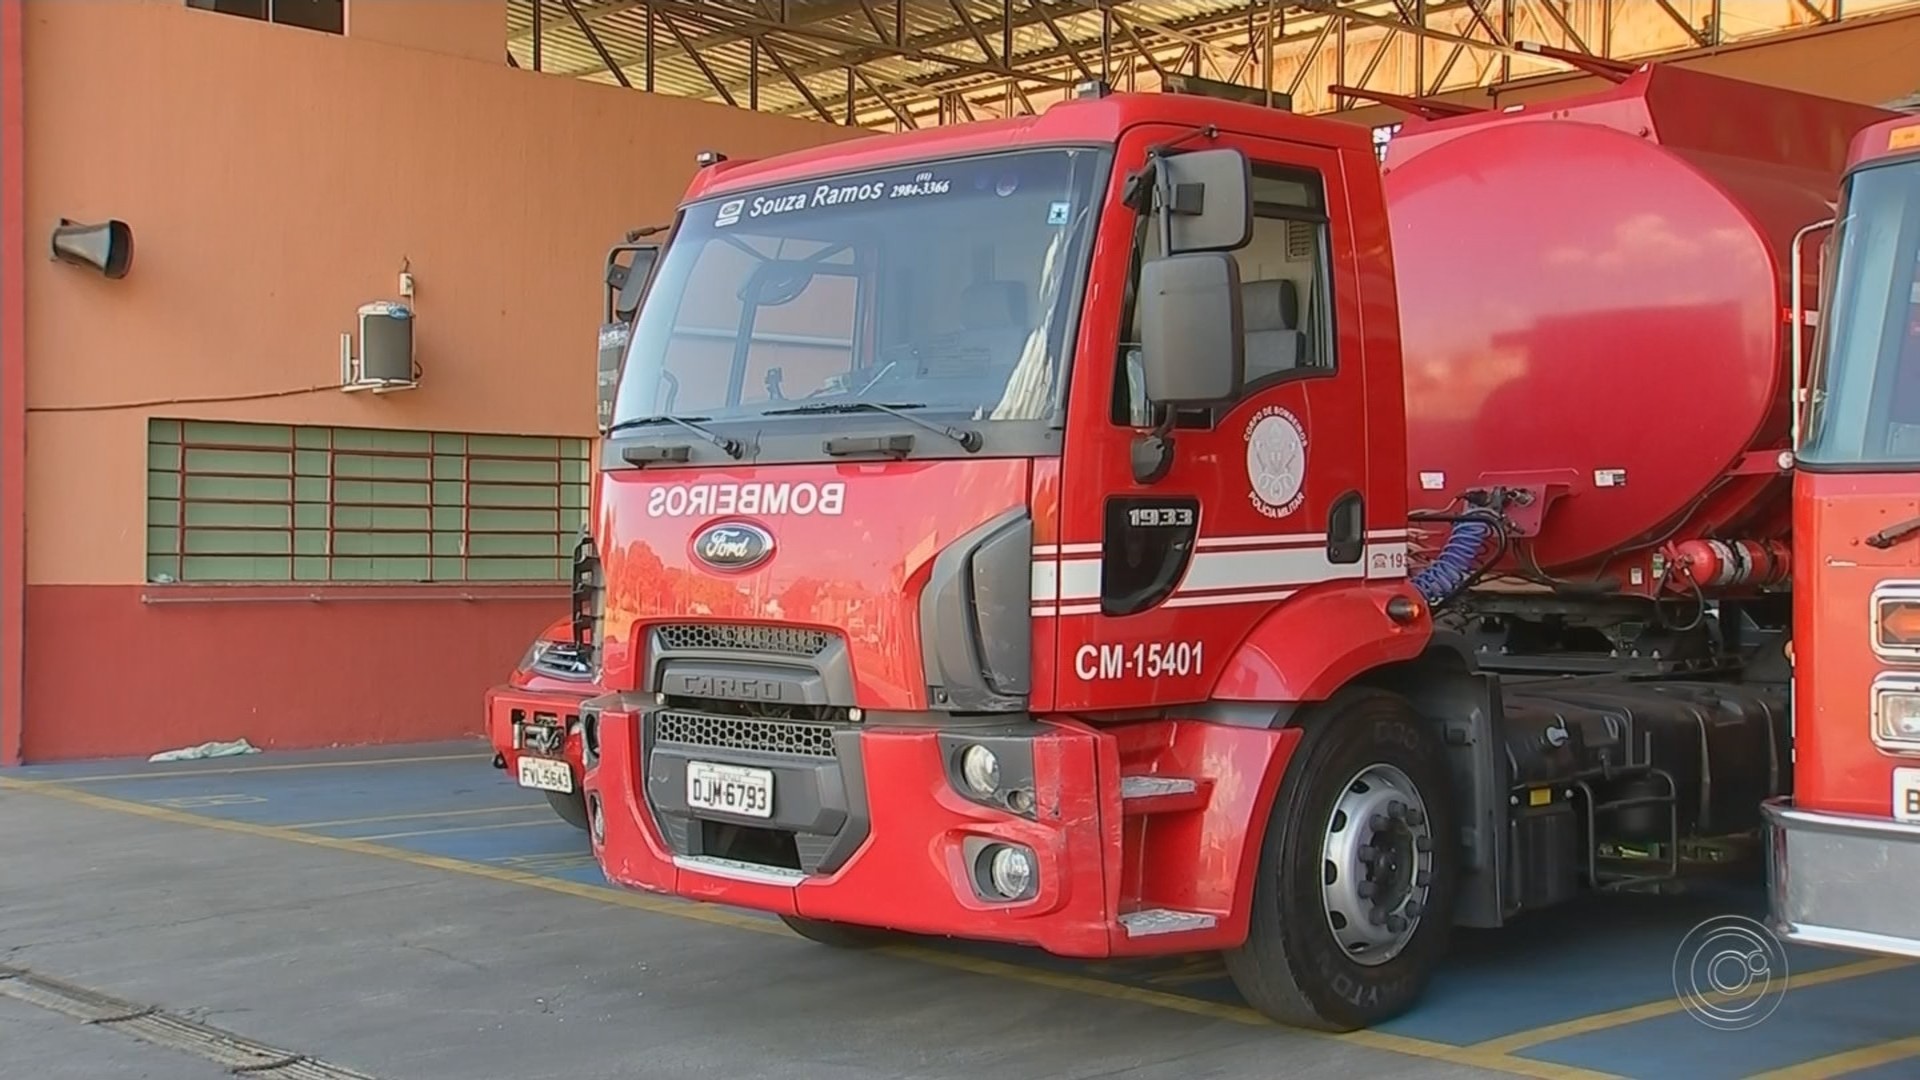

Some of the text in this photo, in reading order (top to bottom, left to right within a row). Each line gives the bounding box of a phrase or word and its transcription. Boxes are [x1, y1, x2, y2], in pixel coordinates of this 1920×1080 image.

[749, 180, 950, 218] Souza Ramos 2984-3366
[1243, 411, 1263, 441] CORPO
[1262, 406, 1273, 416] DE
[1128, 508, 1193, 526] 1933
[1277, 491, 1304, 518] MILITAR
[705, 529, 748, 557] Ford
[1075, 641, 1204, 680] CM-15401
[684, 676, 782, 700] CARGO
[693, 778, 767, 810] DJM-6793
